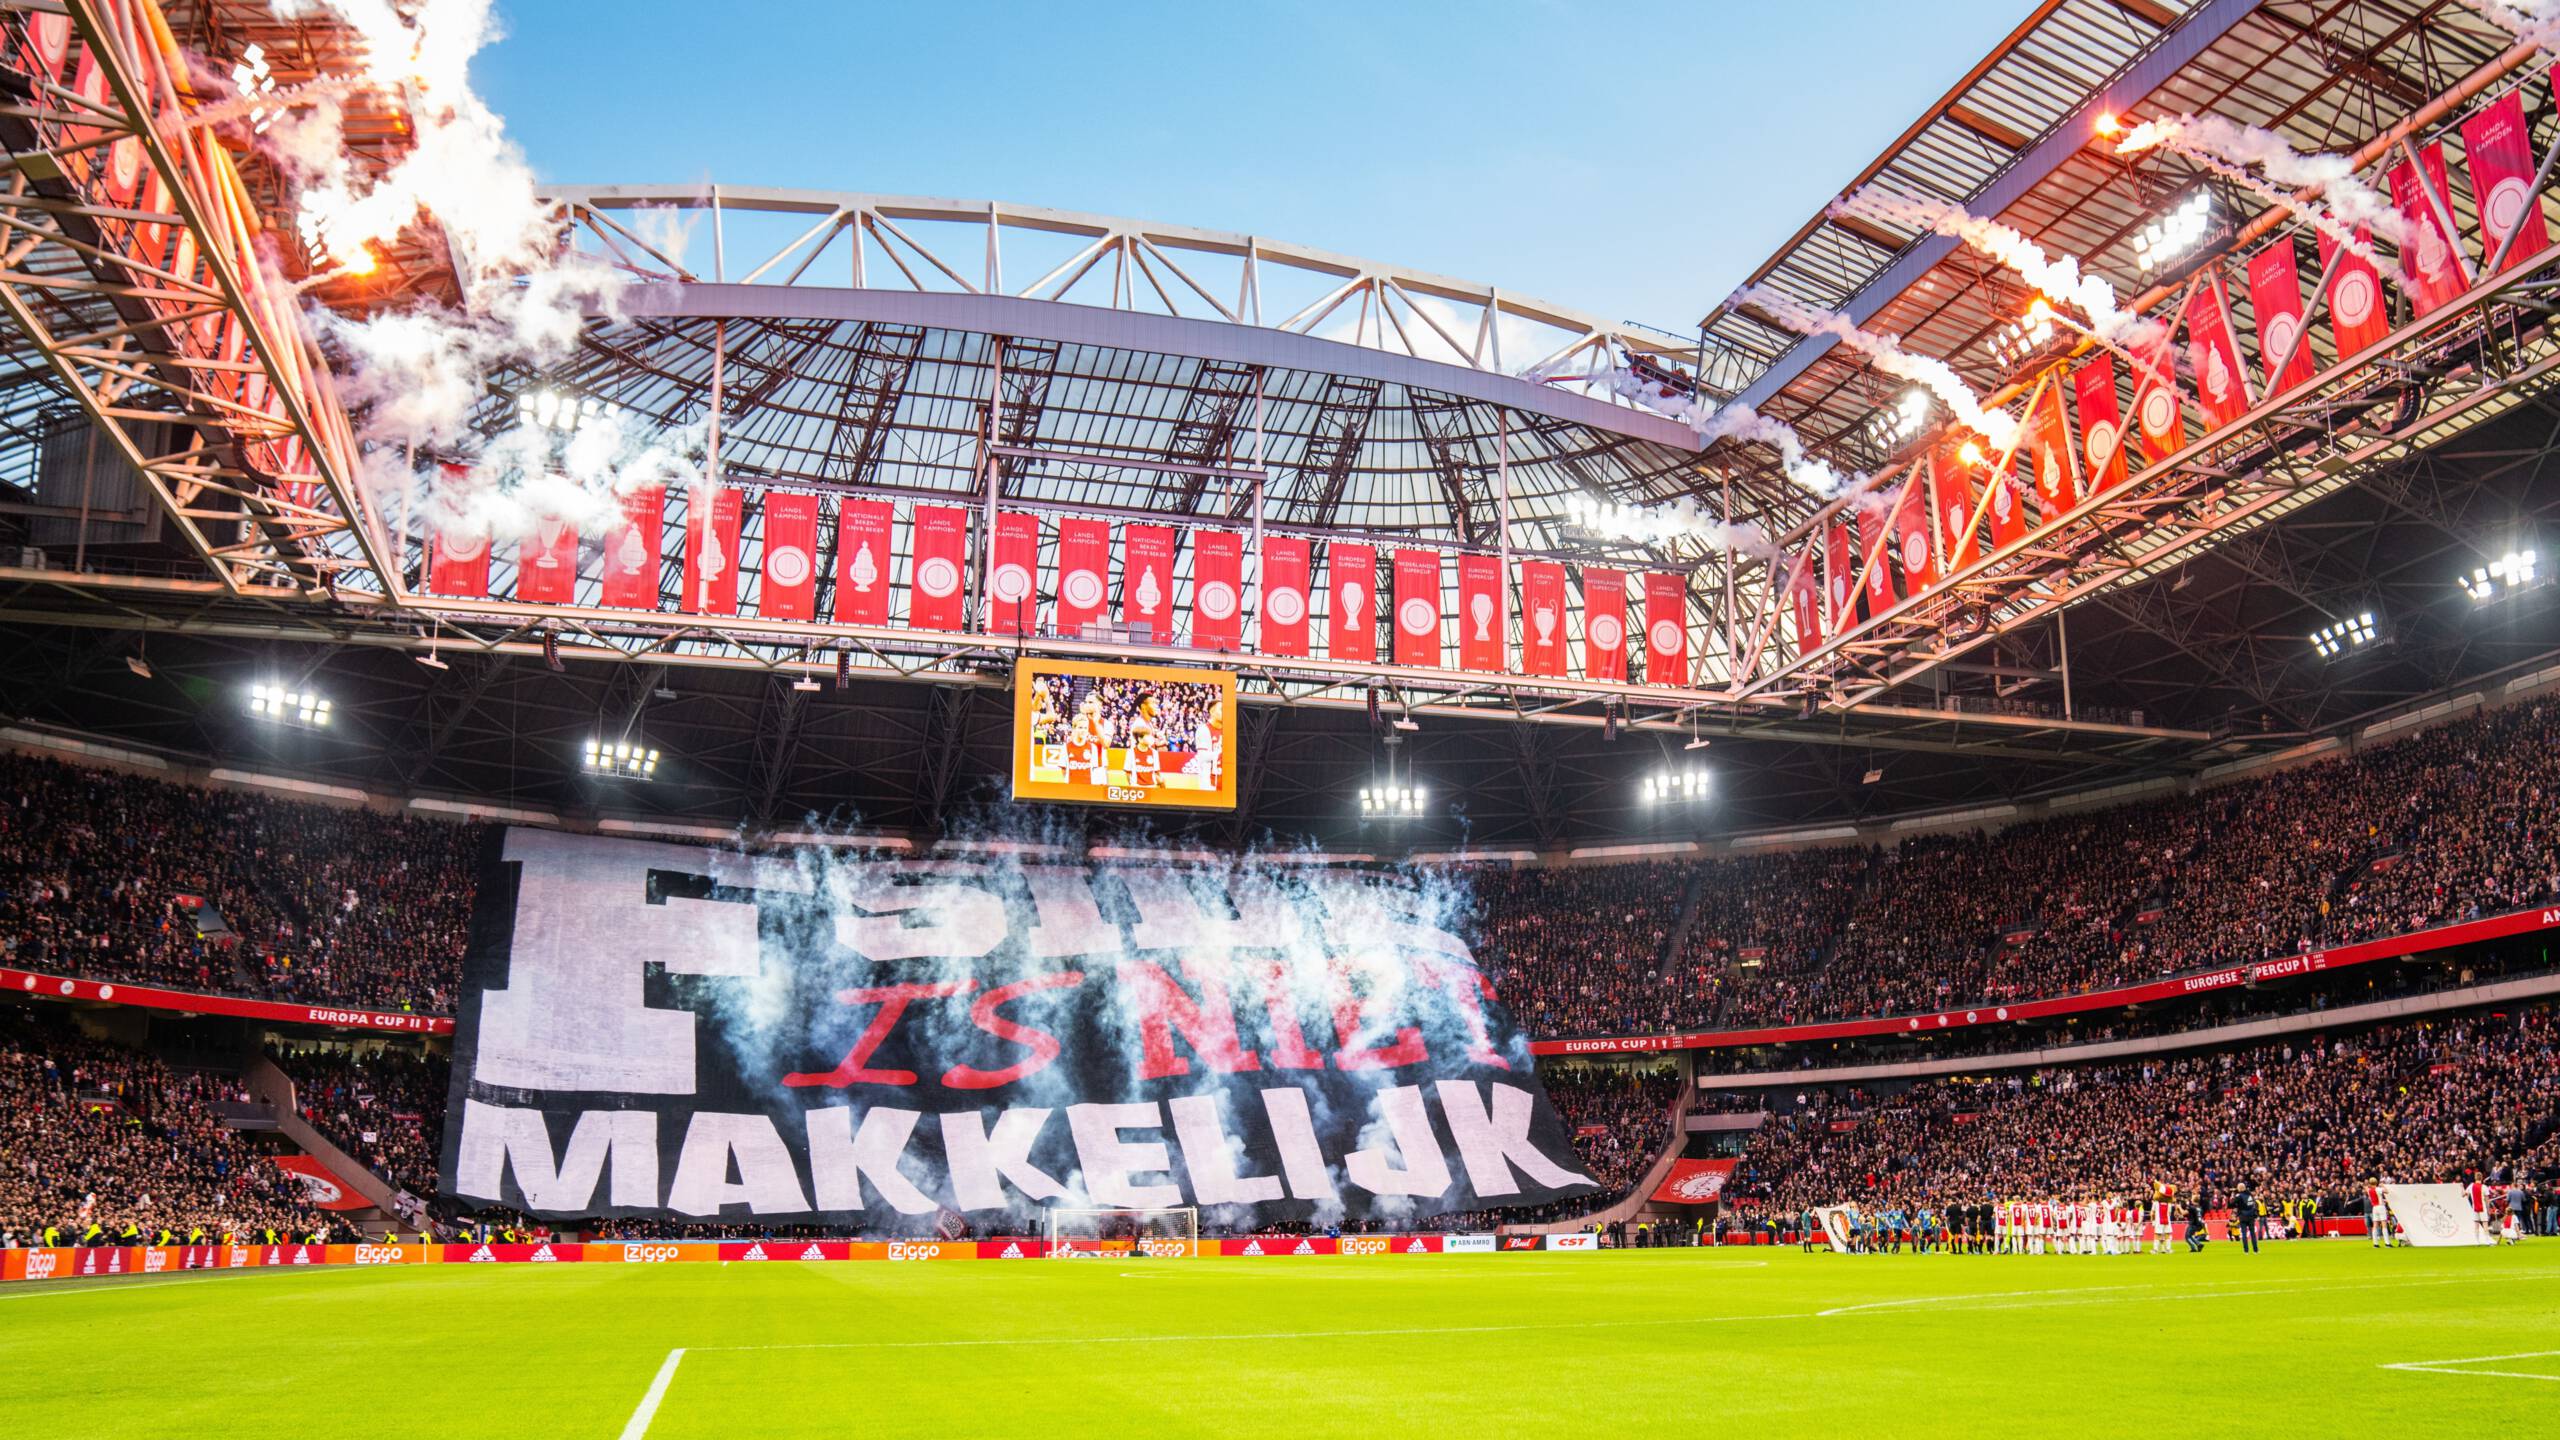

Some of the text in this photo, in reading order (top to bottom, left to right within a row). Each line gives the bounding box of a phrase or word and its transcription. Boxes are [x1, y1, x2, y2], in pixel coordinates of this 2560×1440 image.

[2480, 119, 2505, 140] LANDS
[2475, 124, 2513, 152] KAMPIOEN
[2261, 261, 2280, 278] LANDS
[774, 513, 808, 521] KAMPIOEN
[780, 506, 802, 514] LANDS
[847, 512, 884, 521] NATIONALE
[923, 525, 957, 533] KAMPIOEN
[996, 531, 1029, 539] KAMPIOEN
[1068, 537, 1100, 545] KAMPIOEN
[1132, 537, 1167, 545] NATIONALE
[2184, 972, 2238, 991] EUROPESE
[309, 1010, 421, 1028] EUROPA CUP II
[782, 970, 1085, 1089] IS
[1566, 1041, 1617, 1051] EUROPA
[1621, 1040, 1648, 1049] CUP
[457, 1080, 1600, 1216] MAKKELIJK
[1342, 1238, 1386, 1254] Ziggo
[1511, 1237, 1531, 1248] Bud
[1558, 1238, 1587, 1246] CST
[355, 1244, 403, 1264] Ziggo
[624, 1244, 679, 1262] Ziggo
[888, 1242, 940, 1261] Ziggo
